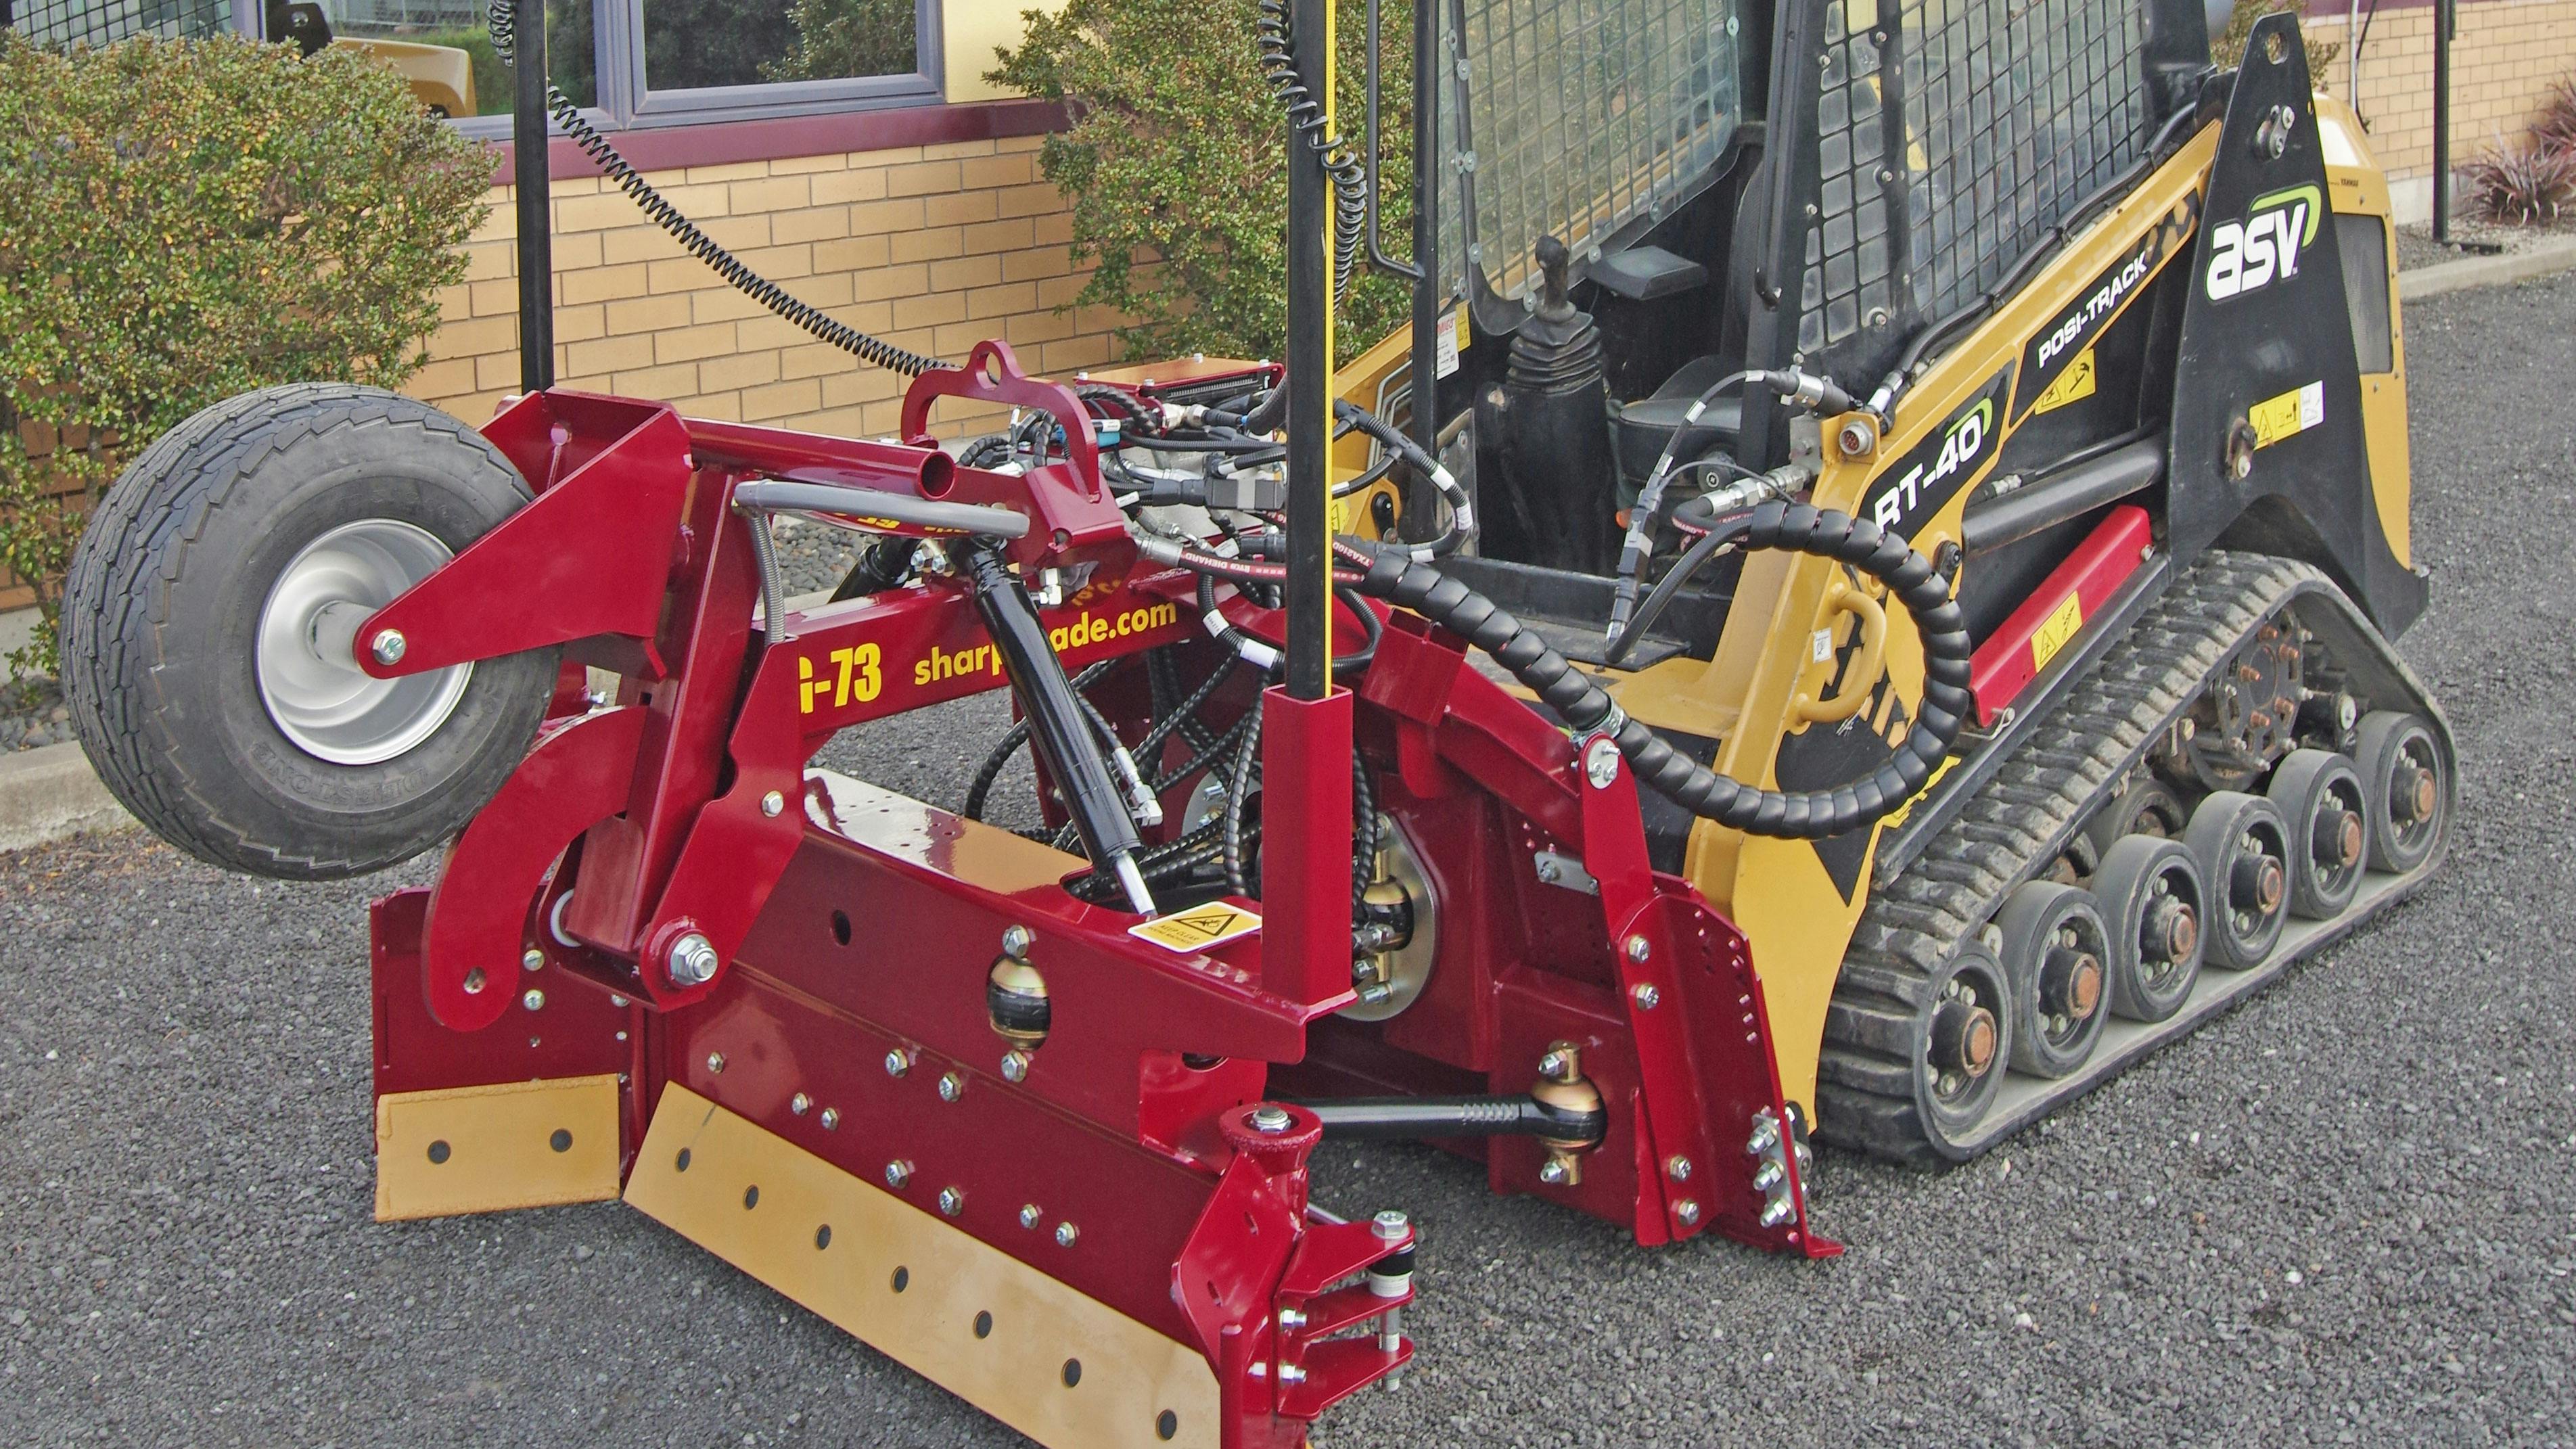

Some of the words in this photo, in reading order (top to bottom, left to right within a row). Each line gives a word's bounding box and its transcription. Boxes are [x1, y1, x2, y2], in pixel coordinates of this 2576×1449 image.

[2038, 251, 2148, 369] POSI-TRACK
[1874, 414, 1982, 534] RT-40
[1184, 552, 1228, 570] DIEHARD
[915, 602, 1176, 685] sharpade.com
